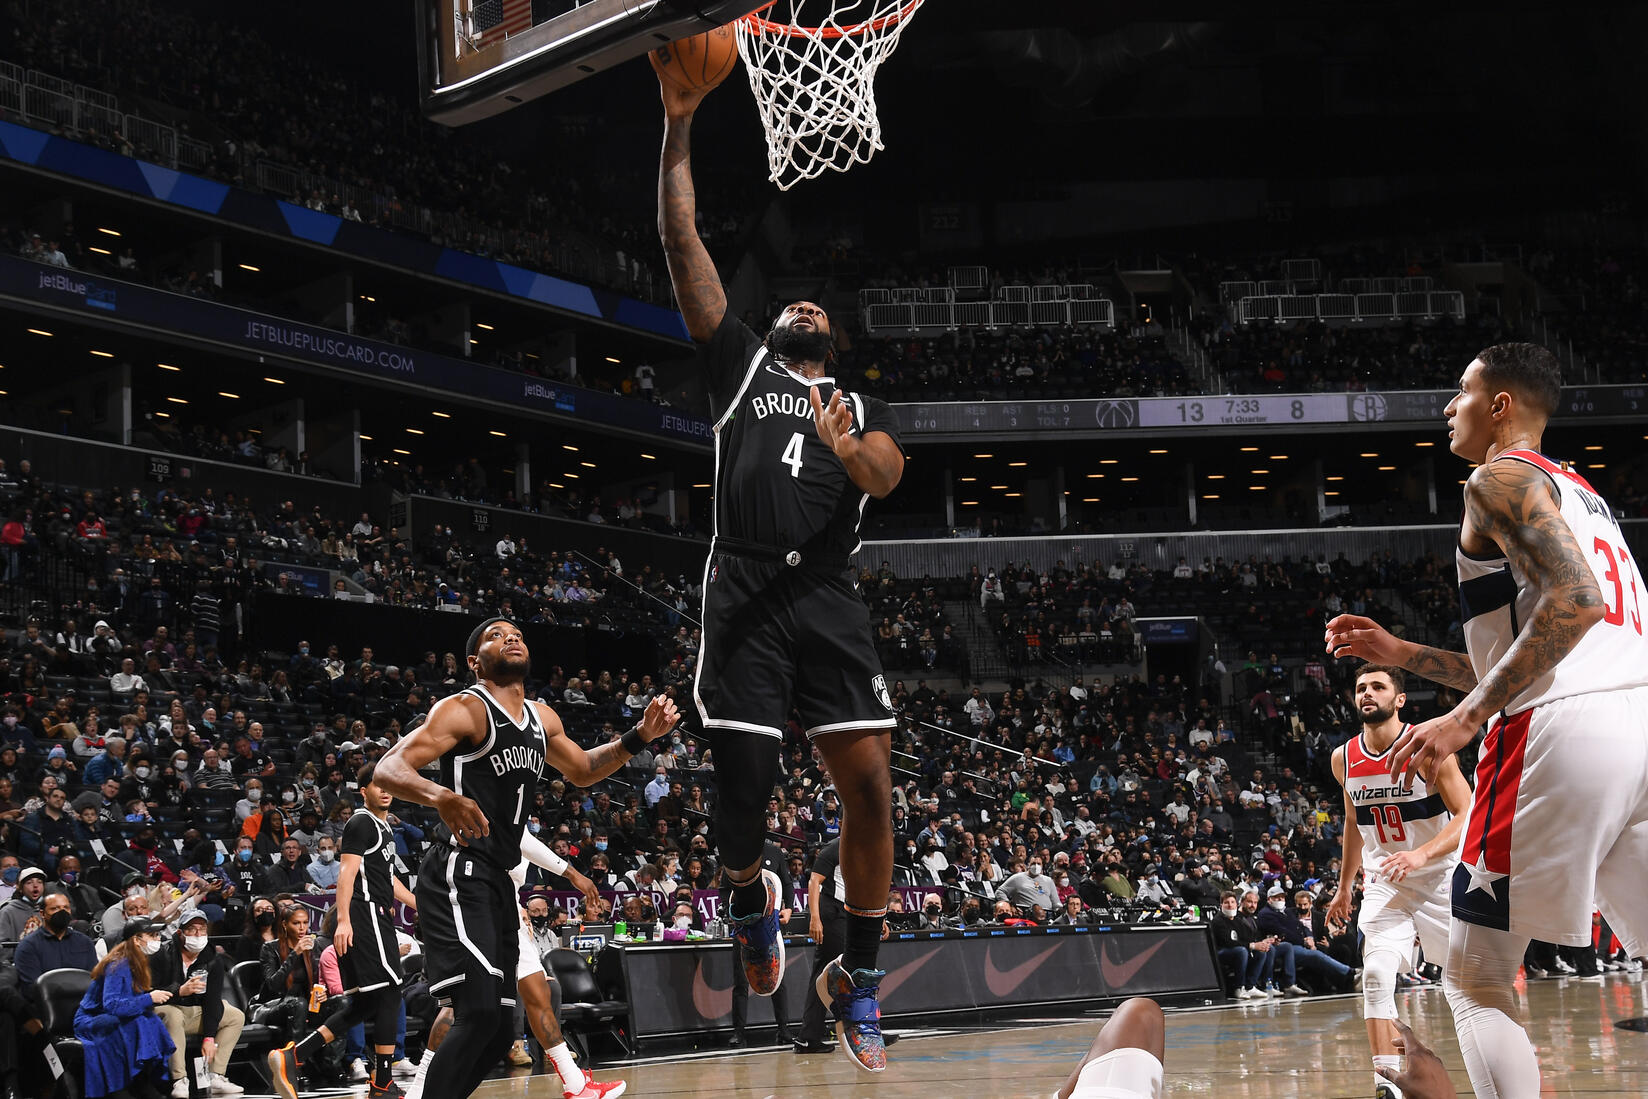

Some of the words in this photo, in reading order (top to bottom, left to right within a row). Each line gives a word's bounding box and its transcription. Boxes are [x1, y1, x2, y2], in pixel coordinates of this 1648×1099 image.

[39, 271, 87, 295] jetBlue
[245, 320, 416, 373] JETBLUEPLUSCARD.COM
[523, 381, 556, 400] jetBlue
[1063, 403, 1070, 413] 0
[1177, 402, 1204, 422] 13
[1225, 400, 1260, 413] 7:33
[1290, 400, 1304, 419] 8
[973, 418, 980, 427] 4
[1064, 416, 1071, 426] 7
[1235, 415, 1268, 423] Quarter
[781, 431, 805, 478] 4
[152, 463, 168, 474] 109
[474, 515, 488, 524] 110
[1594, 537, 1642, 636] 33
[1350, 780, 1413, 800] wizards
[513, 784, 525, 825] 1
[1370, 805, 1406, 844] 19
[245, 881, 252, 891] 7
